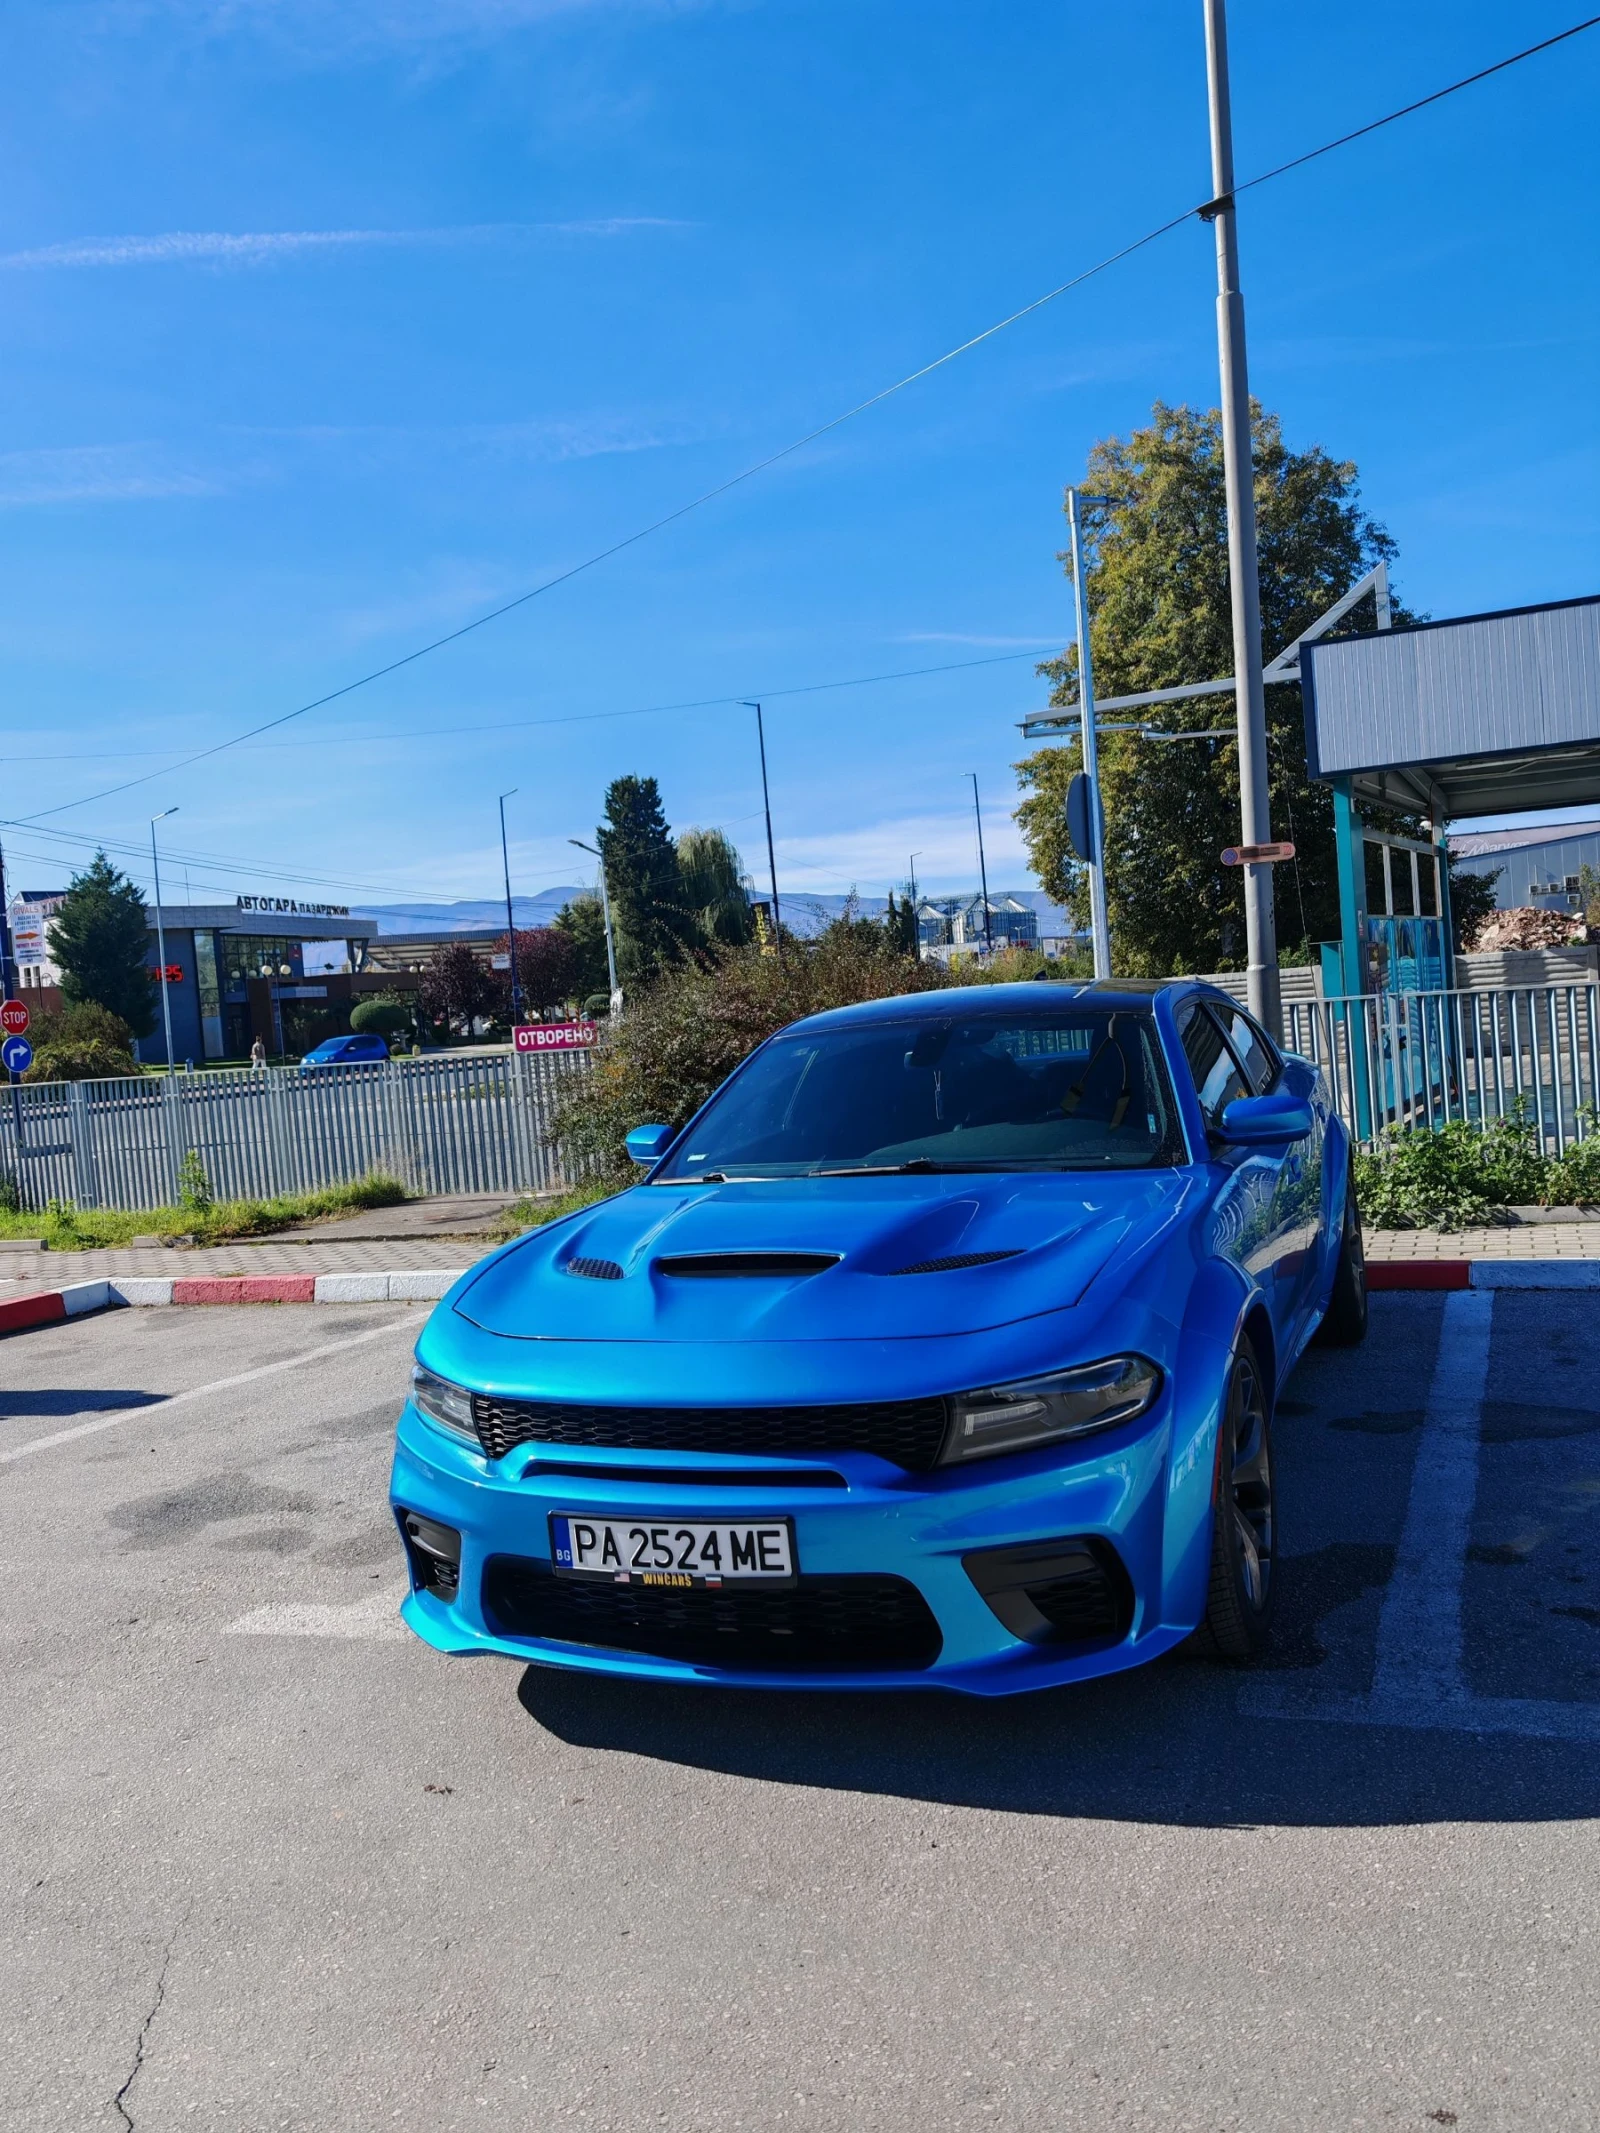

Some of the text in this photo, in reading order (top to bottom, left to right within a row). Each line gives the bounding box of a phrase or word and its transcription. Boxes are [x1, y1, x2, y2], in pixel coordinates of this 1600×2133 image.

[236, 895, 350, 916] АВТОГАРА ПАЗАРДЖИК
[3, 1011, 27, 1024] STOP
[518, 1026, 593, 1046] ОТВОРЕНО
[556, 1549, 571, 1562] BG
[642, 1573, 692, 1588] WINCARS
